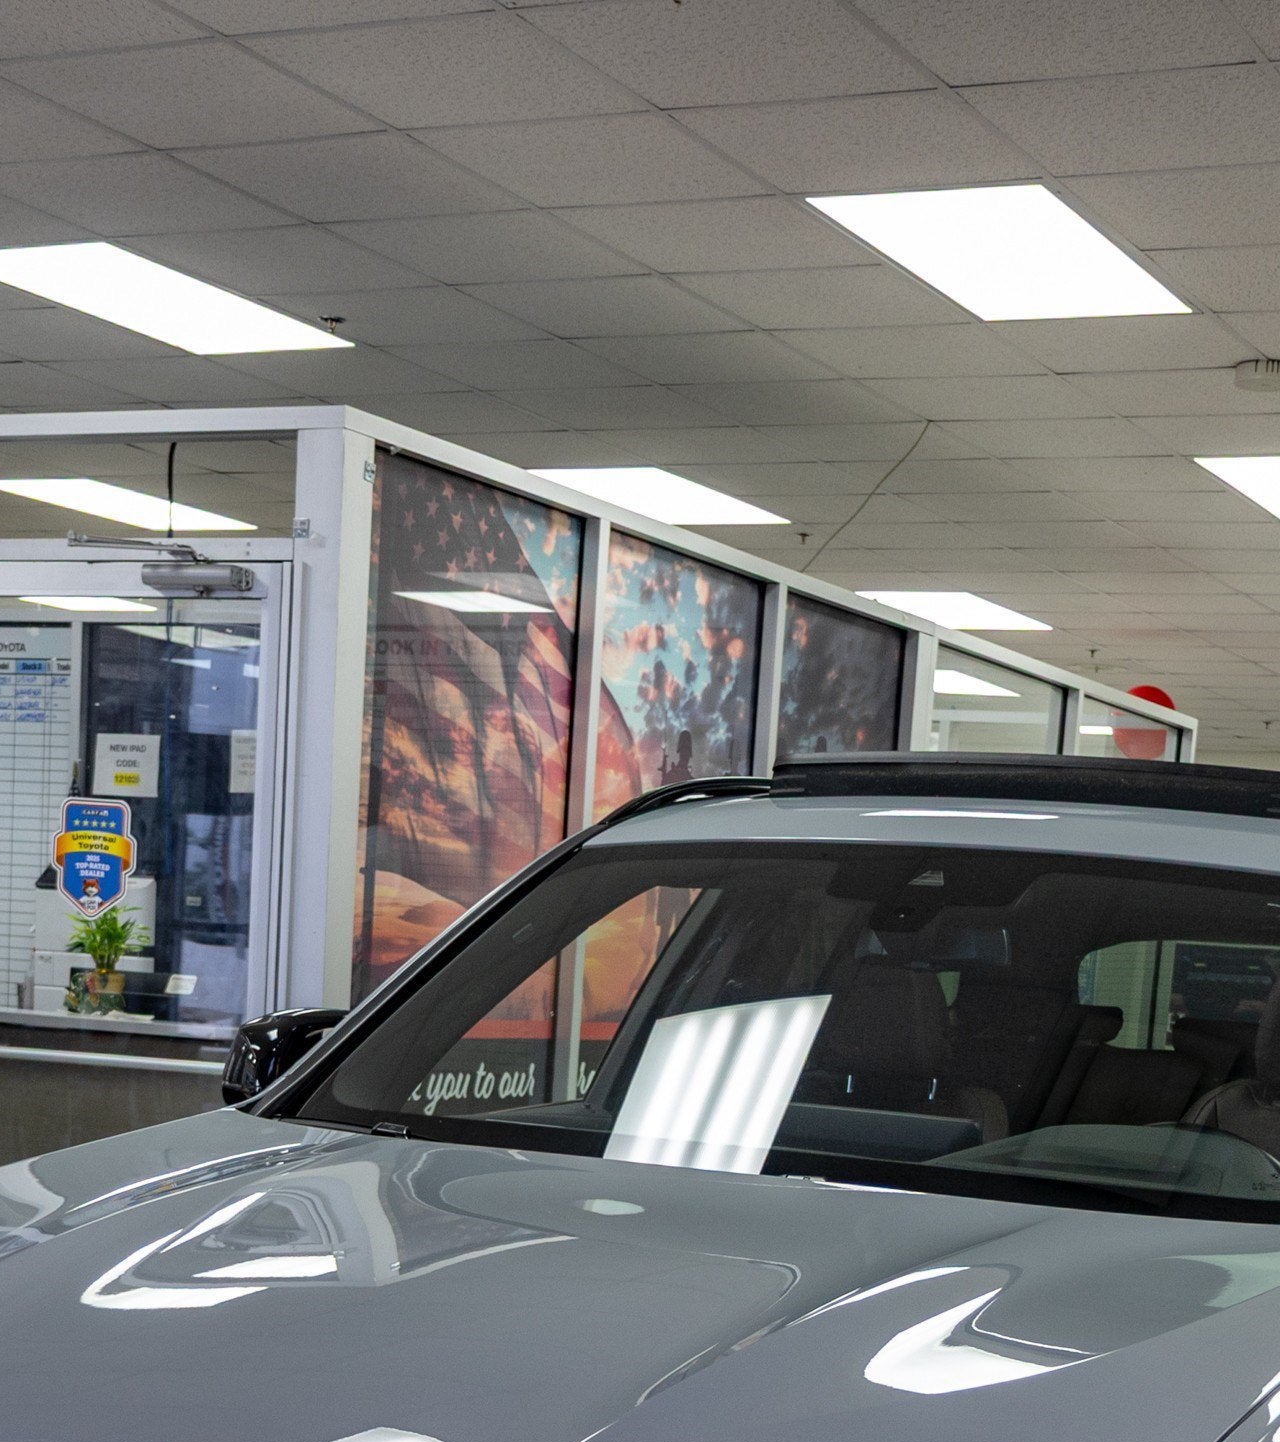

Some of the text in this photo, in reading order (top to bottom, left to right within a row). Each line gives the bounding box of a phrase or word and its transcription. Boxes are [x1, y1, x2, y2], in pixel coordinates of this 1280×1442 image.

[110, 744, 147, 753] NEW IPAD
[72, 833, 116, 843] Universal
[78, 841, 109, 851] Toyota
[75, 862, 110, 871] TOP-RATED
[80, 869, 105, 878] DEALER
[424, 1072, 471, 1116] you
[474, 1062, 495, 1100] to
[498, 1062, 536, 1100] our
